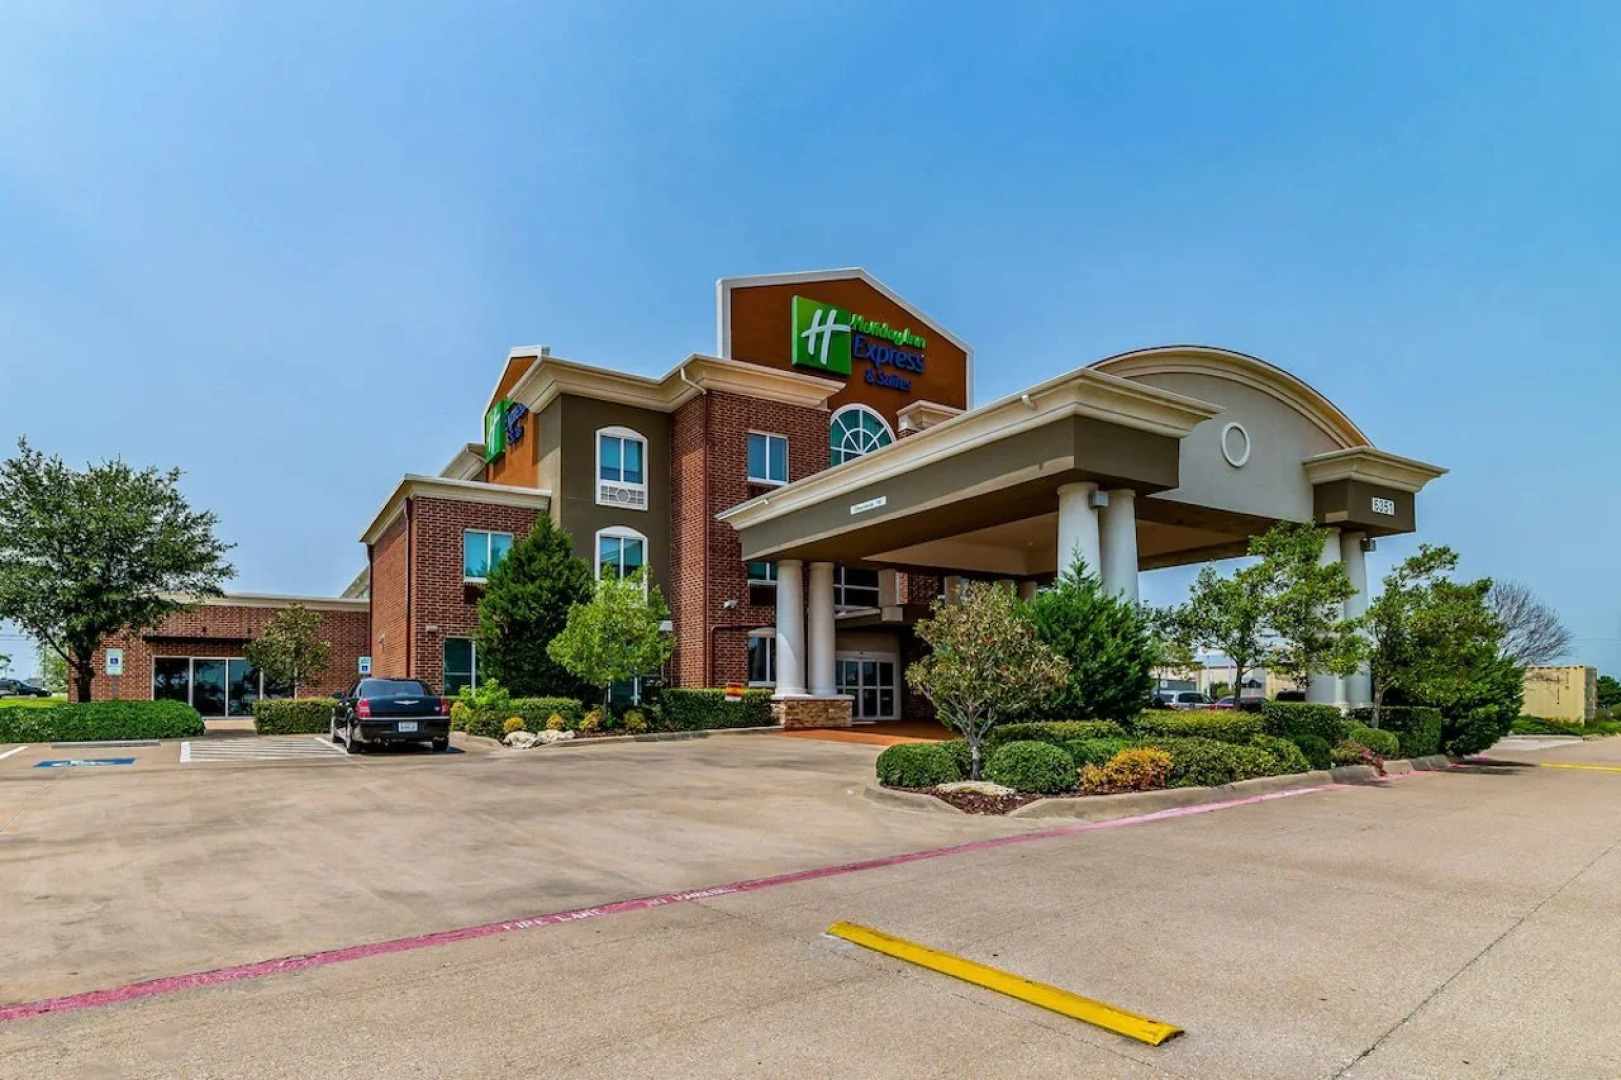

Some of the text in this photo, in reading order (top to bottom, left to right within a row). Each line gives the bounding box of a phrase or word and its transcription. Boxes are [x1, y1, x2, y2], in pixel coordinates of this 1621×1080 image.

[850, 313, 927, 349] Holiday Inn
[853, 333, 925, 374] Express
[865, 367, 912, 391] & Suites
